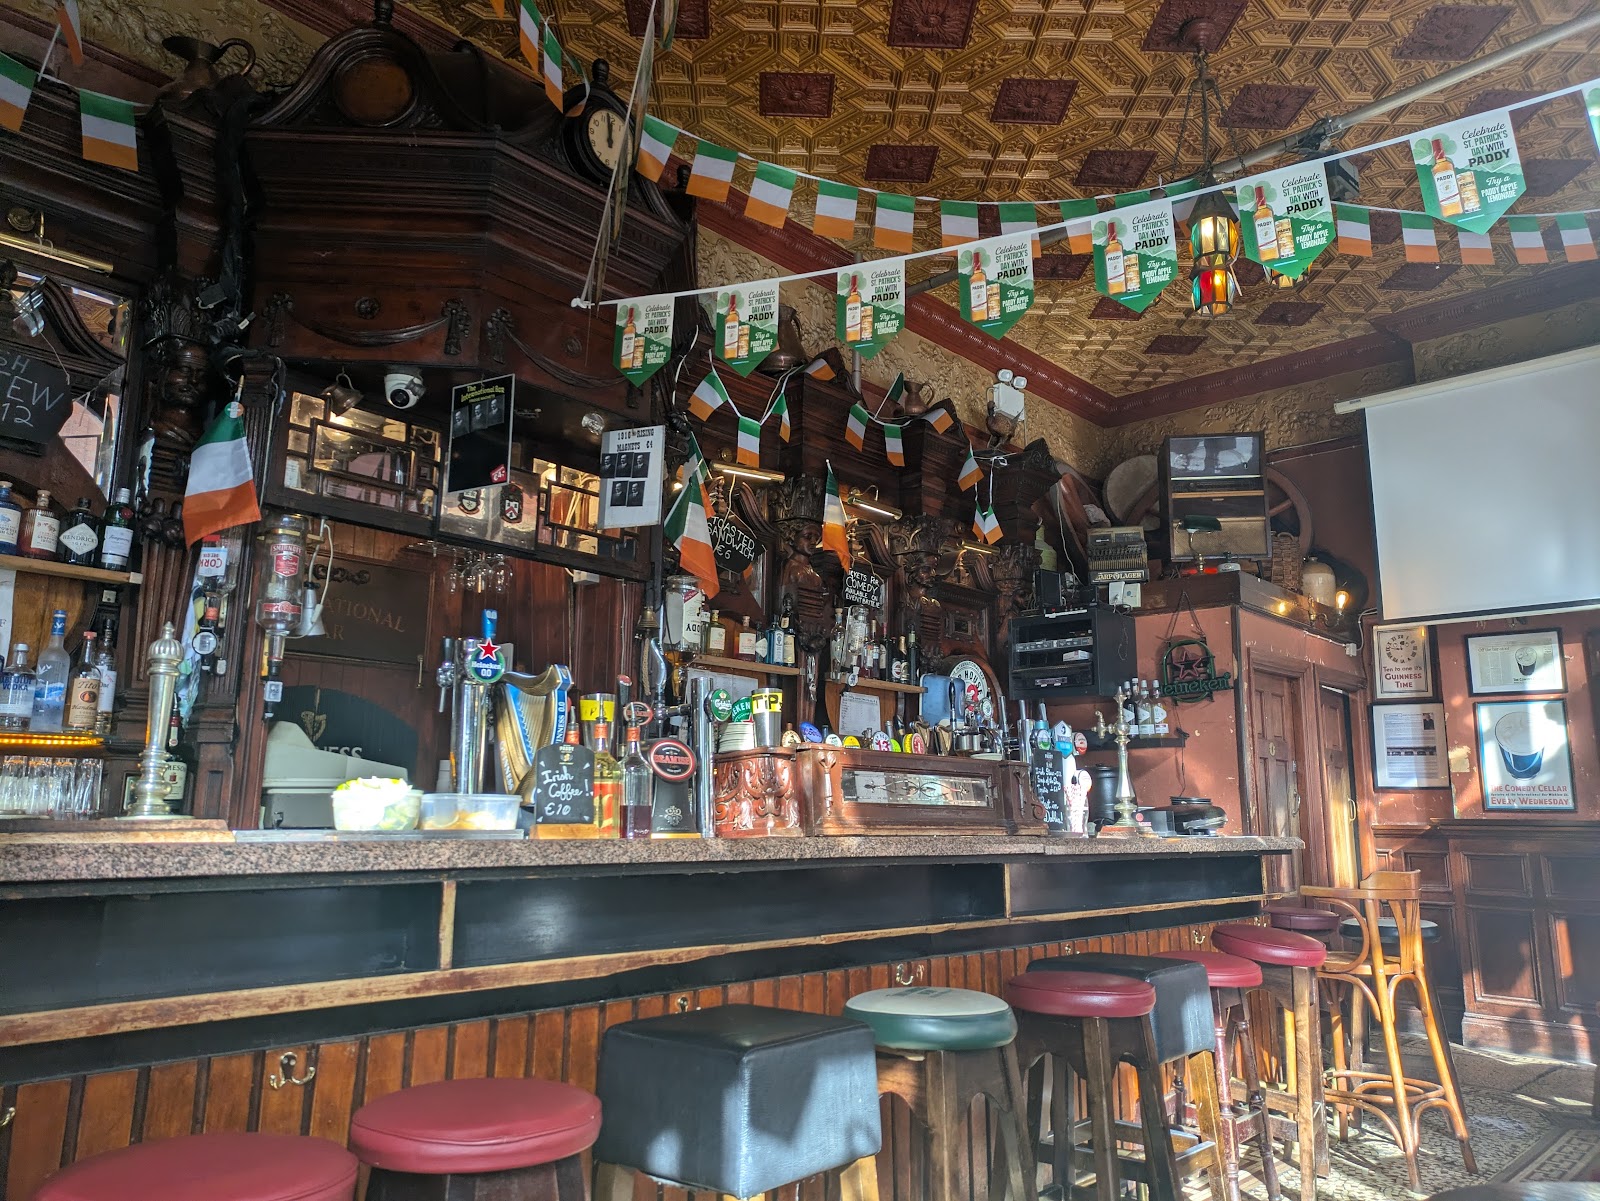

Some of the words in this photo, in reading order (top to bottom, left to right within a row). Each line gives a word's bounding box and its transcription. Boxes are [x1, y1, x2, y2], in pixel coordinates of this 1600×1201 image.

[1462, 122, 1506, 141] Celebrate
[1463, 140, 1474, 149] ST.
[1474, 129, 1508, 147] PATRICK'S
[1471, 146, 1485, 156] DAY
[1485, 141, 1505, 152] WITH
[1468, 148, 1511, 168] PADDY
[1281, 172, 1321, 188] Celebrate
[1486, 176, 1503, 186] Try
[1282, 188, 1292, 197] ST.
[1292, 179, 1323, 195] PATRICK'S
[1481, 187, 1500, 197] PADDY
[1500, 182, 1518, 191] APPLE
[1289, 194, 1302, 204] DAY
[1302, 190, 1319, 200] WITH
[1487, 191, 1517, 204] LEMONADE
[1286, 197, 1325, 215] PADDY
[1132, 211, 1168, 225] Celebrate
[1141, 219, 1169, 231] PATRICK'S
[1301, 224, 1316, 234] Try
[1138, 230, 1150, 240] DAY
[1150, 228, 1166, 238] WITH
[995, 243, 1027, 255] Celebrate
[1135, 236, 1170, 250] PADDY
[995, 255, 1003, 263] ST.
[1003, 249, 1028, 262] PATRICK'S
[1000, 261, 1011, 270] DAY
[1011, 258, 1025, 268] WITH
[1147, 260, 1160, 269] Try
[871, 269, 901, 279] Celebrate
[997, 266, 1028, 280] PADDY
[878, 276, 901, 285] PATRICK'S
[748, 289, 775, 299] Celebrate
[875, 285, 885, 294] DAY
[885, 284, 898, 292] WITH
[871, 291, 901, 302] PADDY
[645, 304, 671, 312] Celebrate
[748, 311, 775, 322] PADDY
[644, 325, 669, 334] PADDY
[618, 431, 631, 440] 1916
[637, 428, 654, 438] RISING
[617, 442, 640, 452] MAGNETS
[846, 576, 879, 595] COMEDY
[471, 661, 502, 670] Heineken
[875, 740, 890, 751] 13
[541, 765, 574, 785] Irish
[1504, 784, 1536, 792] COMEDY
[1538, 784, 1567, 792] CELLAR
[1491, 797, 1516, 805] EVERY
[1519, 797, 1569, 805] WEDNESDAY
[544, 802, 571, 816] €10
